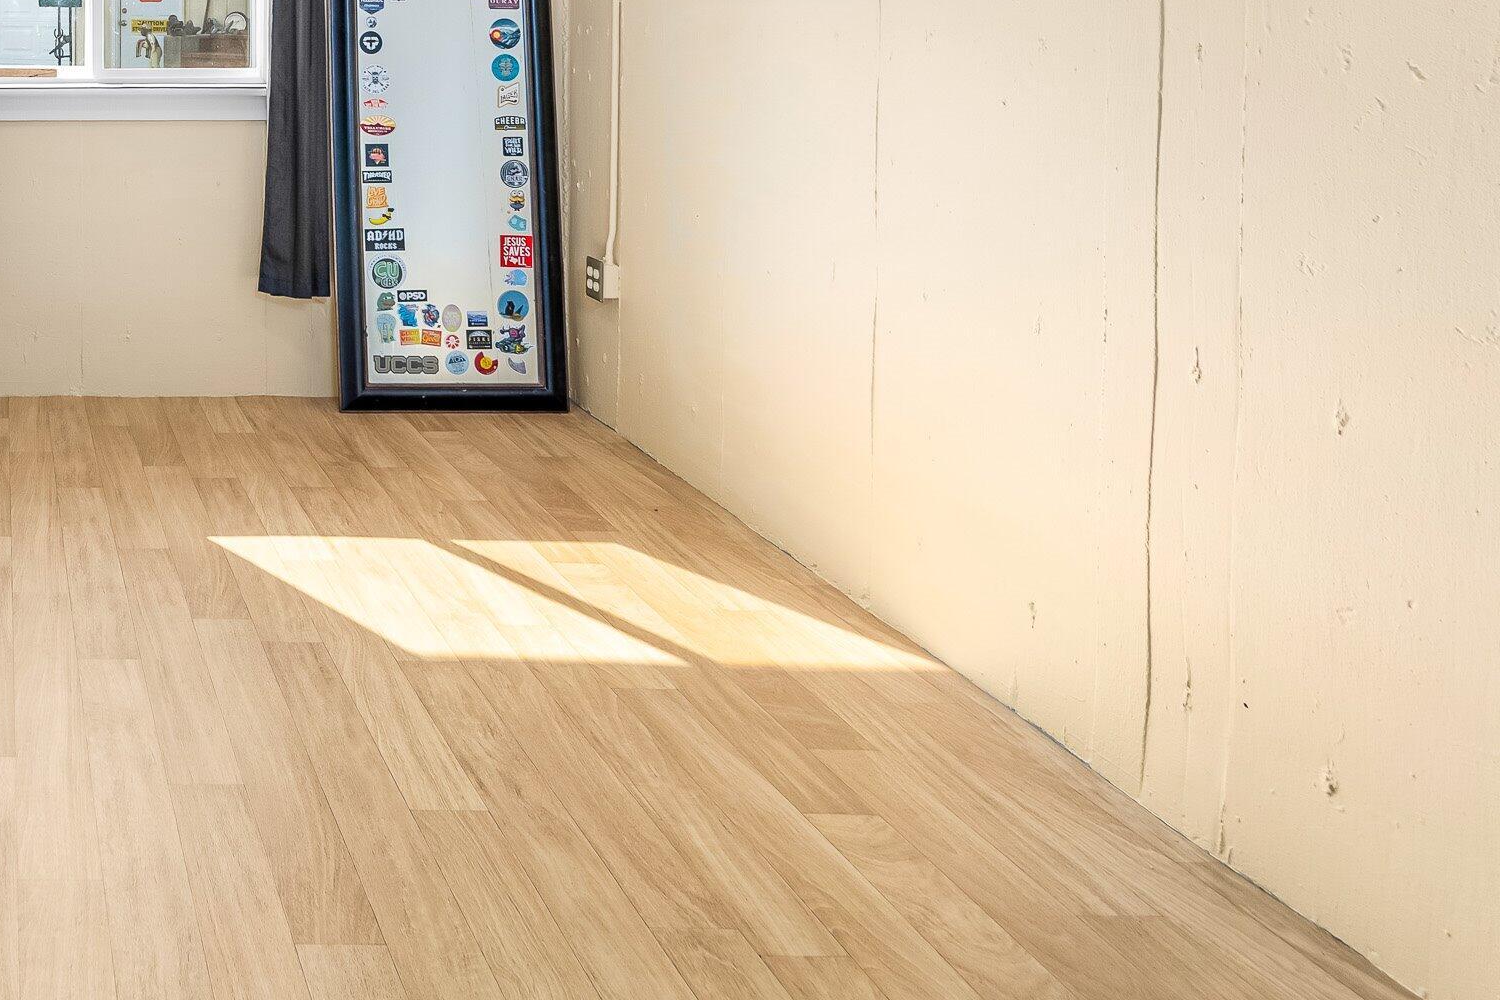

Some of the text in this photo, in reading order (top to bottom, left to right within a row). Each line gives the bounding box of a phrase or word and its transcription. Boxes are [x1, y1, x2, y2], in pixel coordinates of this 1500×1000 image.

[374, 242, 398, 250] ROCKS
[504, 237, 526, 246] JESUS
[503, 246, 531, 257] SAVES
[406, 292, 426, 300] PSD
[373, 355, 439, 374] UCCS
